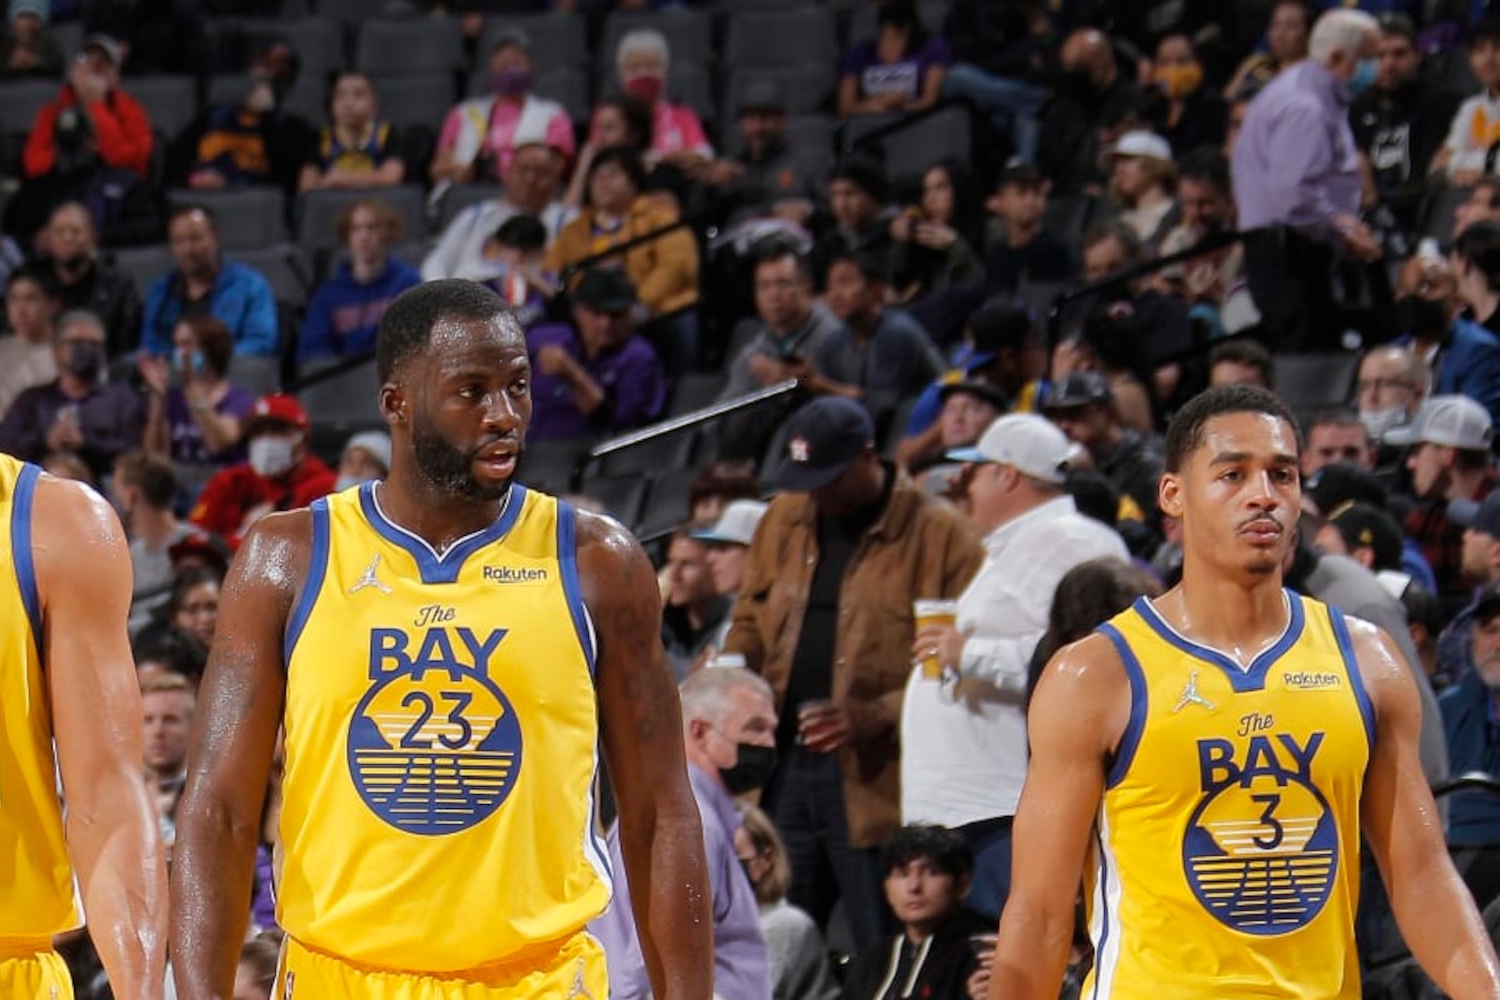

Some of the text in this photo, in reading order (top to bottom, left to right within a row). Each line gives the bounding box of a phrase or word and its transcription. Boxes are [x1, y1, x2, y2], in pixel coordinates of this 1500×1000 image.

[482, 565, 548, 582] Rakuten
[414, 604, 457, 628] The
[368, 627, 510, 683] BAY
[1283, 672, 1341, 688] Rakuten
[400, 691, 473, 750] 23
[1237, 712, 1275, 738] The
[1196, 732, 1326, 793] BAY
[1249, 794, 1284, 850] 3
